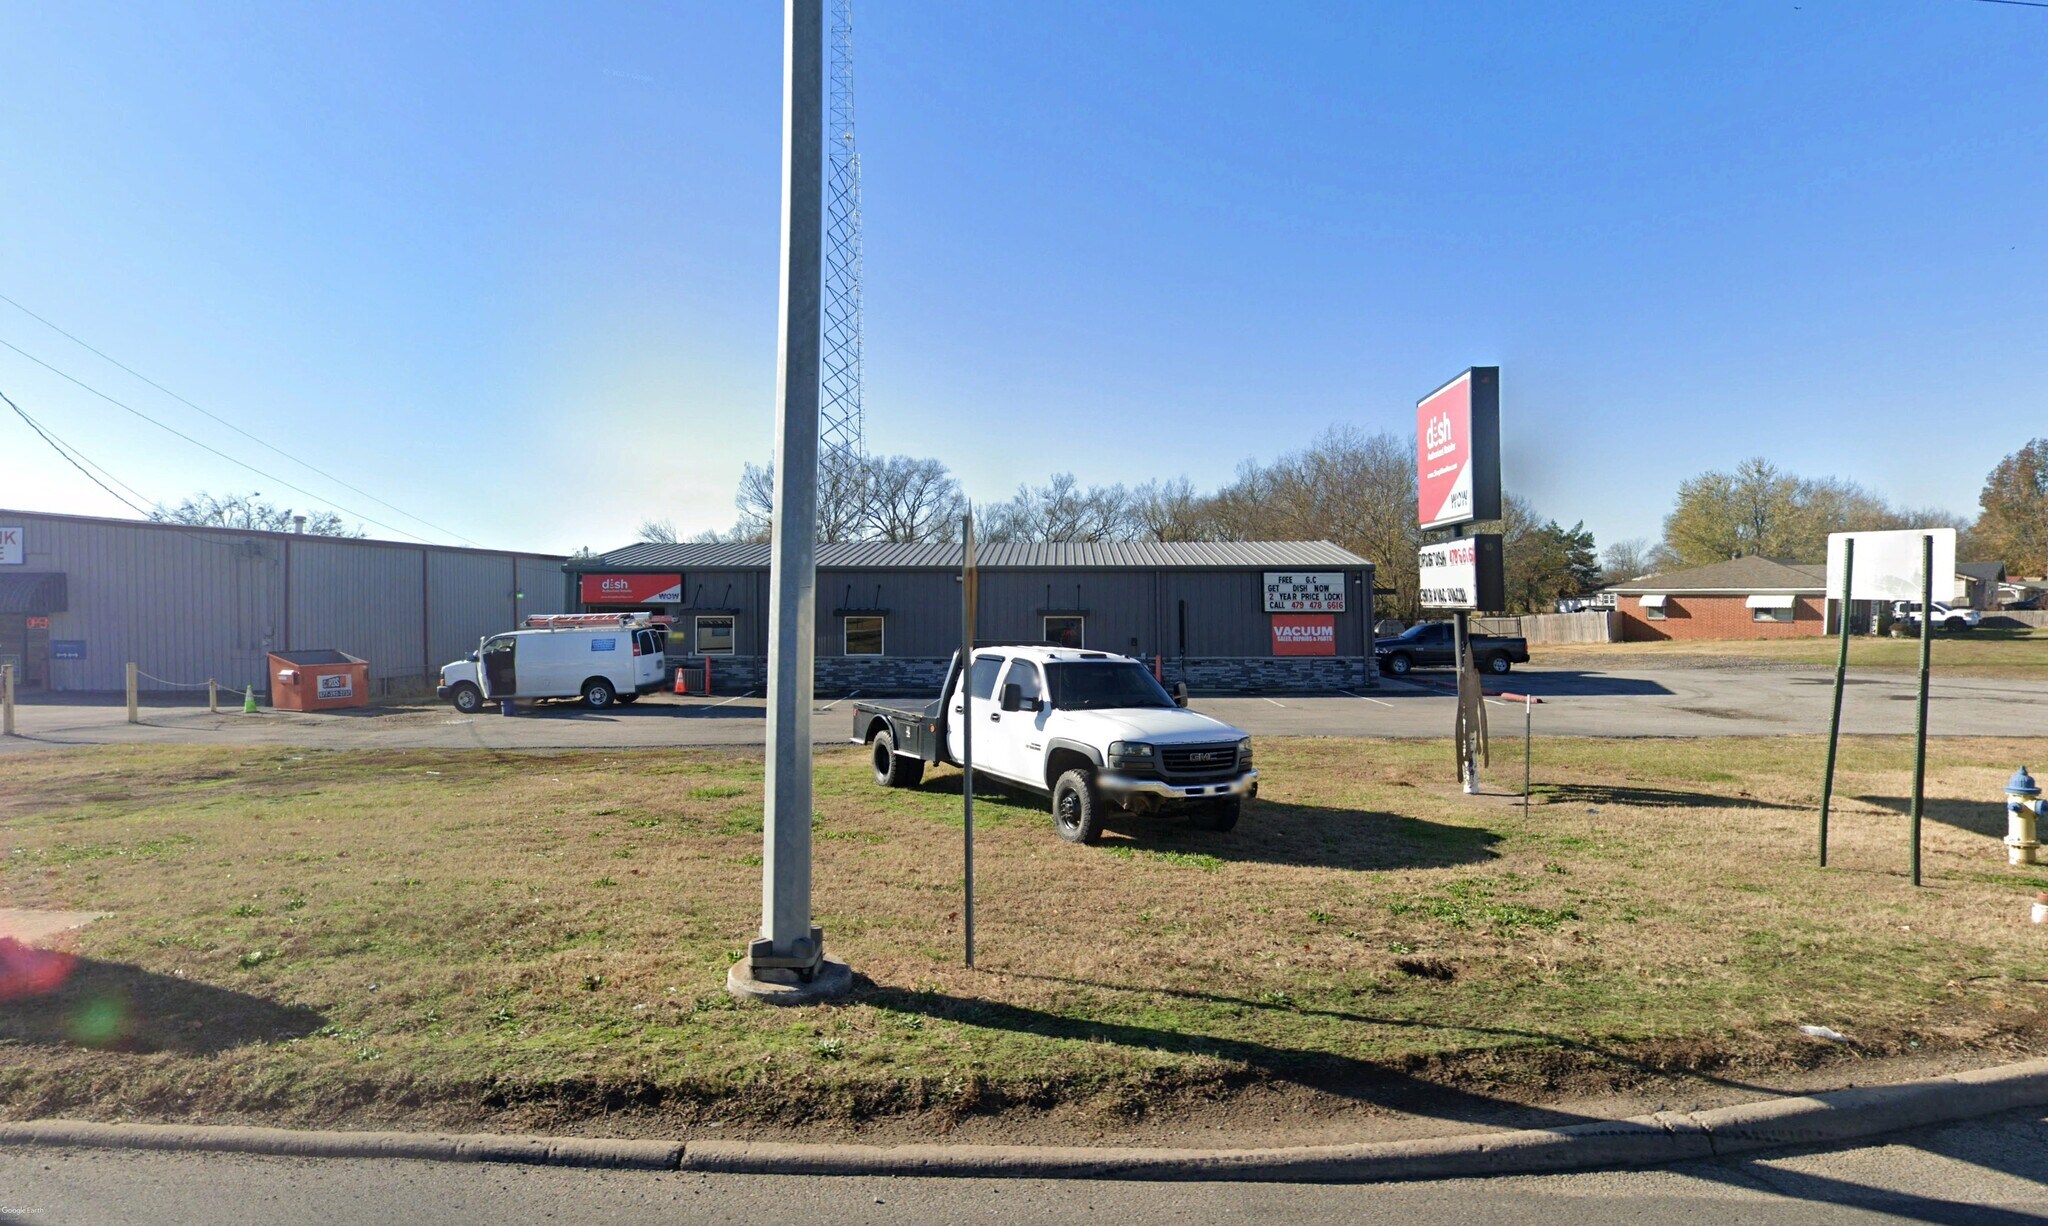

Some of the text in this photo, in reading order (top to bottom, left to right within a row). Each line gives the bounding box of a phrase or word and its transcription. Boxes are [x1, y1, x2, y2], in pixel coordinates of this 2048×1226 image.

[1426, 411, 1452, 450] dish
[601, 578, 628, 589] dish
[1269, 601, 1285, 609] CALL
[1291, 601, 1305, 609] 479
[1309, 601, 1323, 609] 478
[1273, 626, 1333, 636] VACUUM
[1189, 752, 1218, 762] GMC
